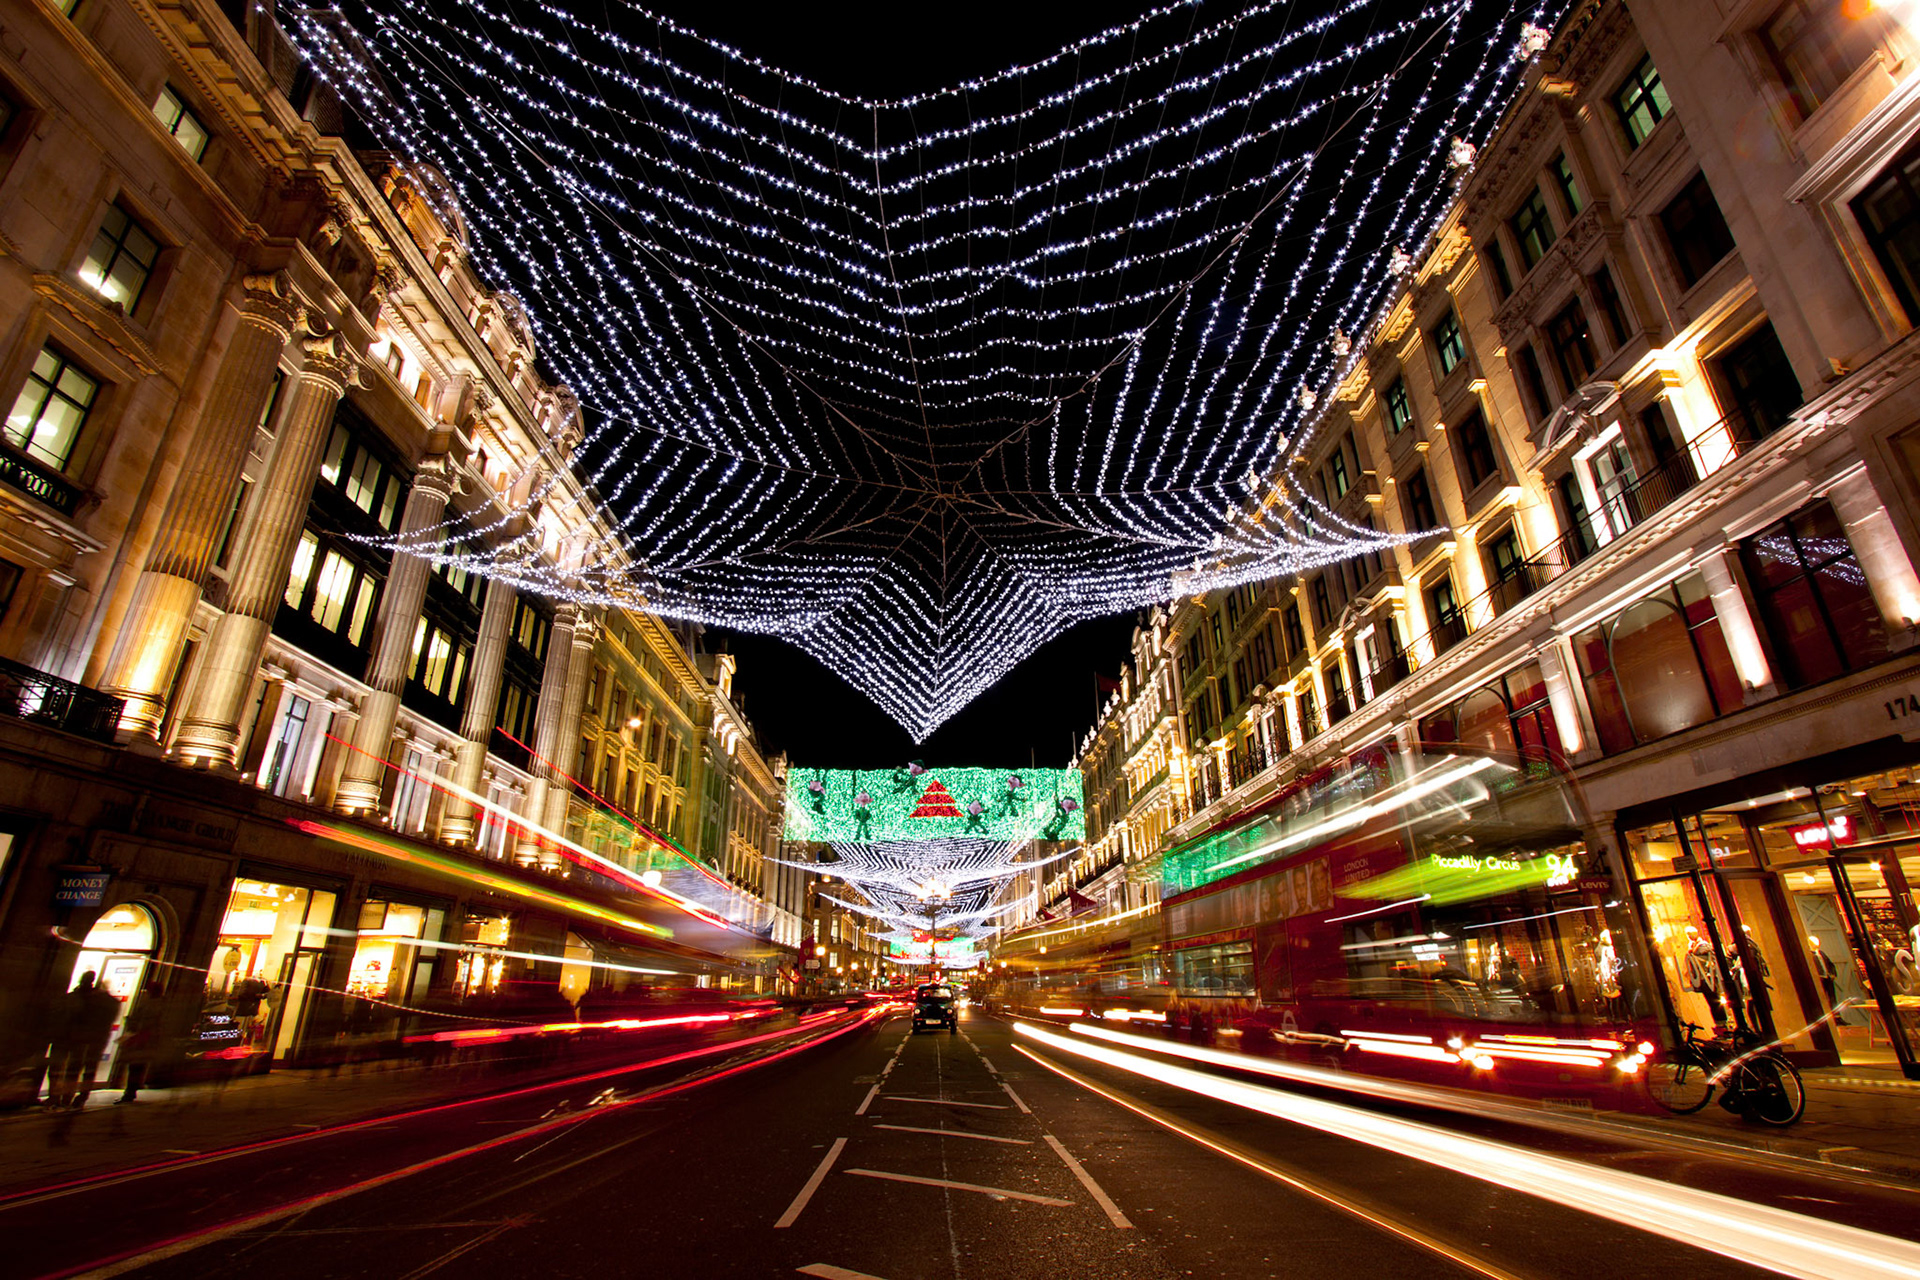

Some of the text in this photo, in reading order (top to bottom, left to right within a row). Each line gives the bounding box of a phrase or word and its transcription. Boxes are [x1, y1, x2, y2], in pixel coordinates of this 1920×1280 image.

[1431, 854, 1521, 872] Piccadilly Circus
[1545, 853, 1579, 880] 94
[61, 878, 106, 888] MONEY
[56, 891, 102, 900] CHANGE
